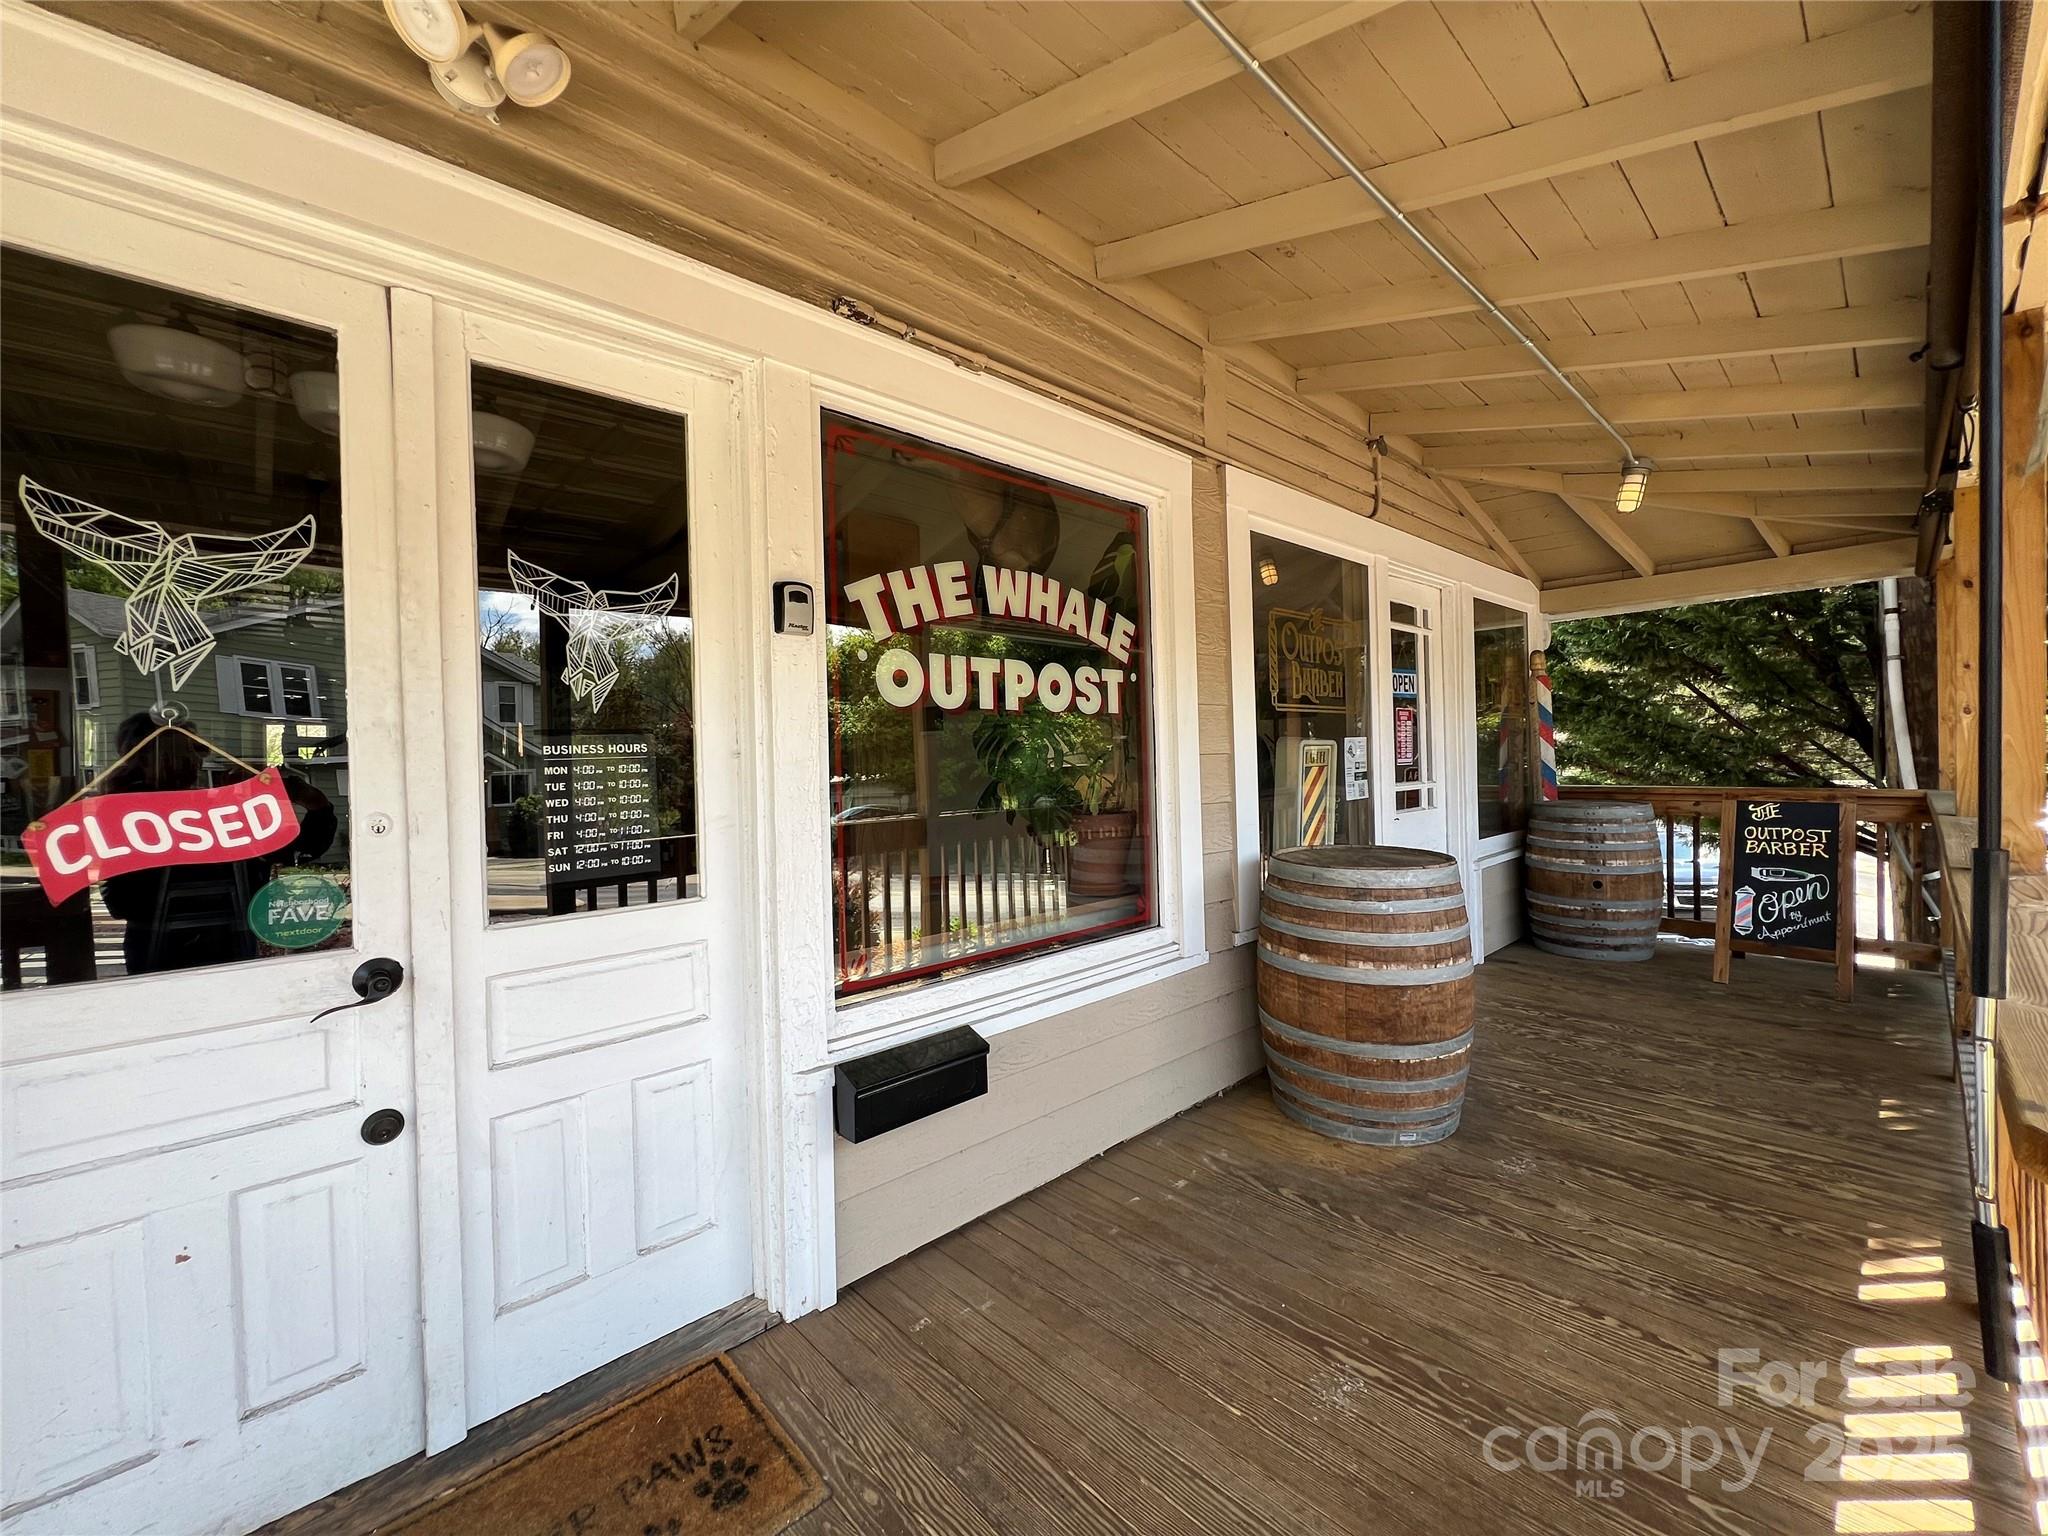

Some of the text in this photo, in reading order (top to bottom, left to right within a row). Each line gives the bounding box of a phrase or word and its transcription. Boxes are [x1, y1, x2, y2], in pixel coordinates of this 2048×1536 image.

[844, 561, 1136, 665] THE WHALE
[1281, 621, 1343, 666] OUTPOS
[875, 648, 1125, 715] OUTPOST
[1392, 674, 1415, 692] OPEN
[543, 743, 648, 755] BUSINESS HOURS
[544, 766, 568, 775] MON
[545, 783, 566, 791] TUE
[545, 799, 569, 808] WED
[1748, 802, 1783, 821] THE
[546, 815, 569, 824] THU
[45, 794, 282, 875] CLOSED
[547, 831, 564, 840] FRI
[1744, 826, 1832, 843] OUTPOST
[547, 847, 569, 856] SAT
[1745, 839, 1829, 858] BARBER
[548, 863, 571, 873] SUN
[1758, 880, 1827, 923] Open
[268, 904, 330, 925] FAVE
[275, 927, 323, 938] nextdoor
